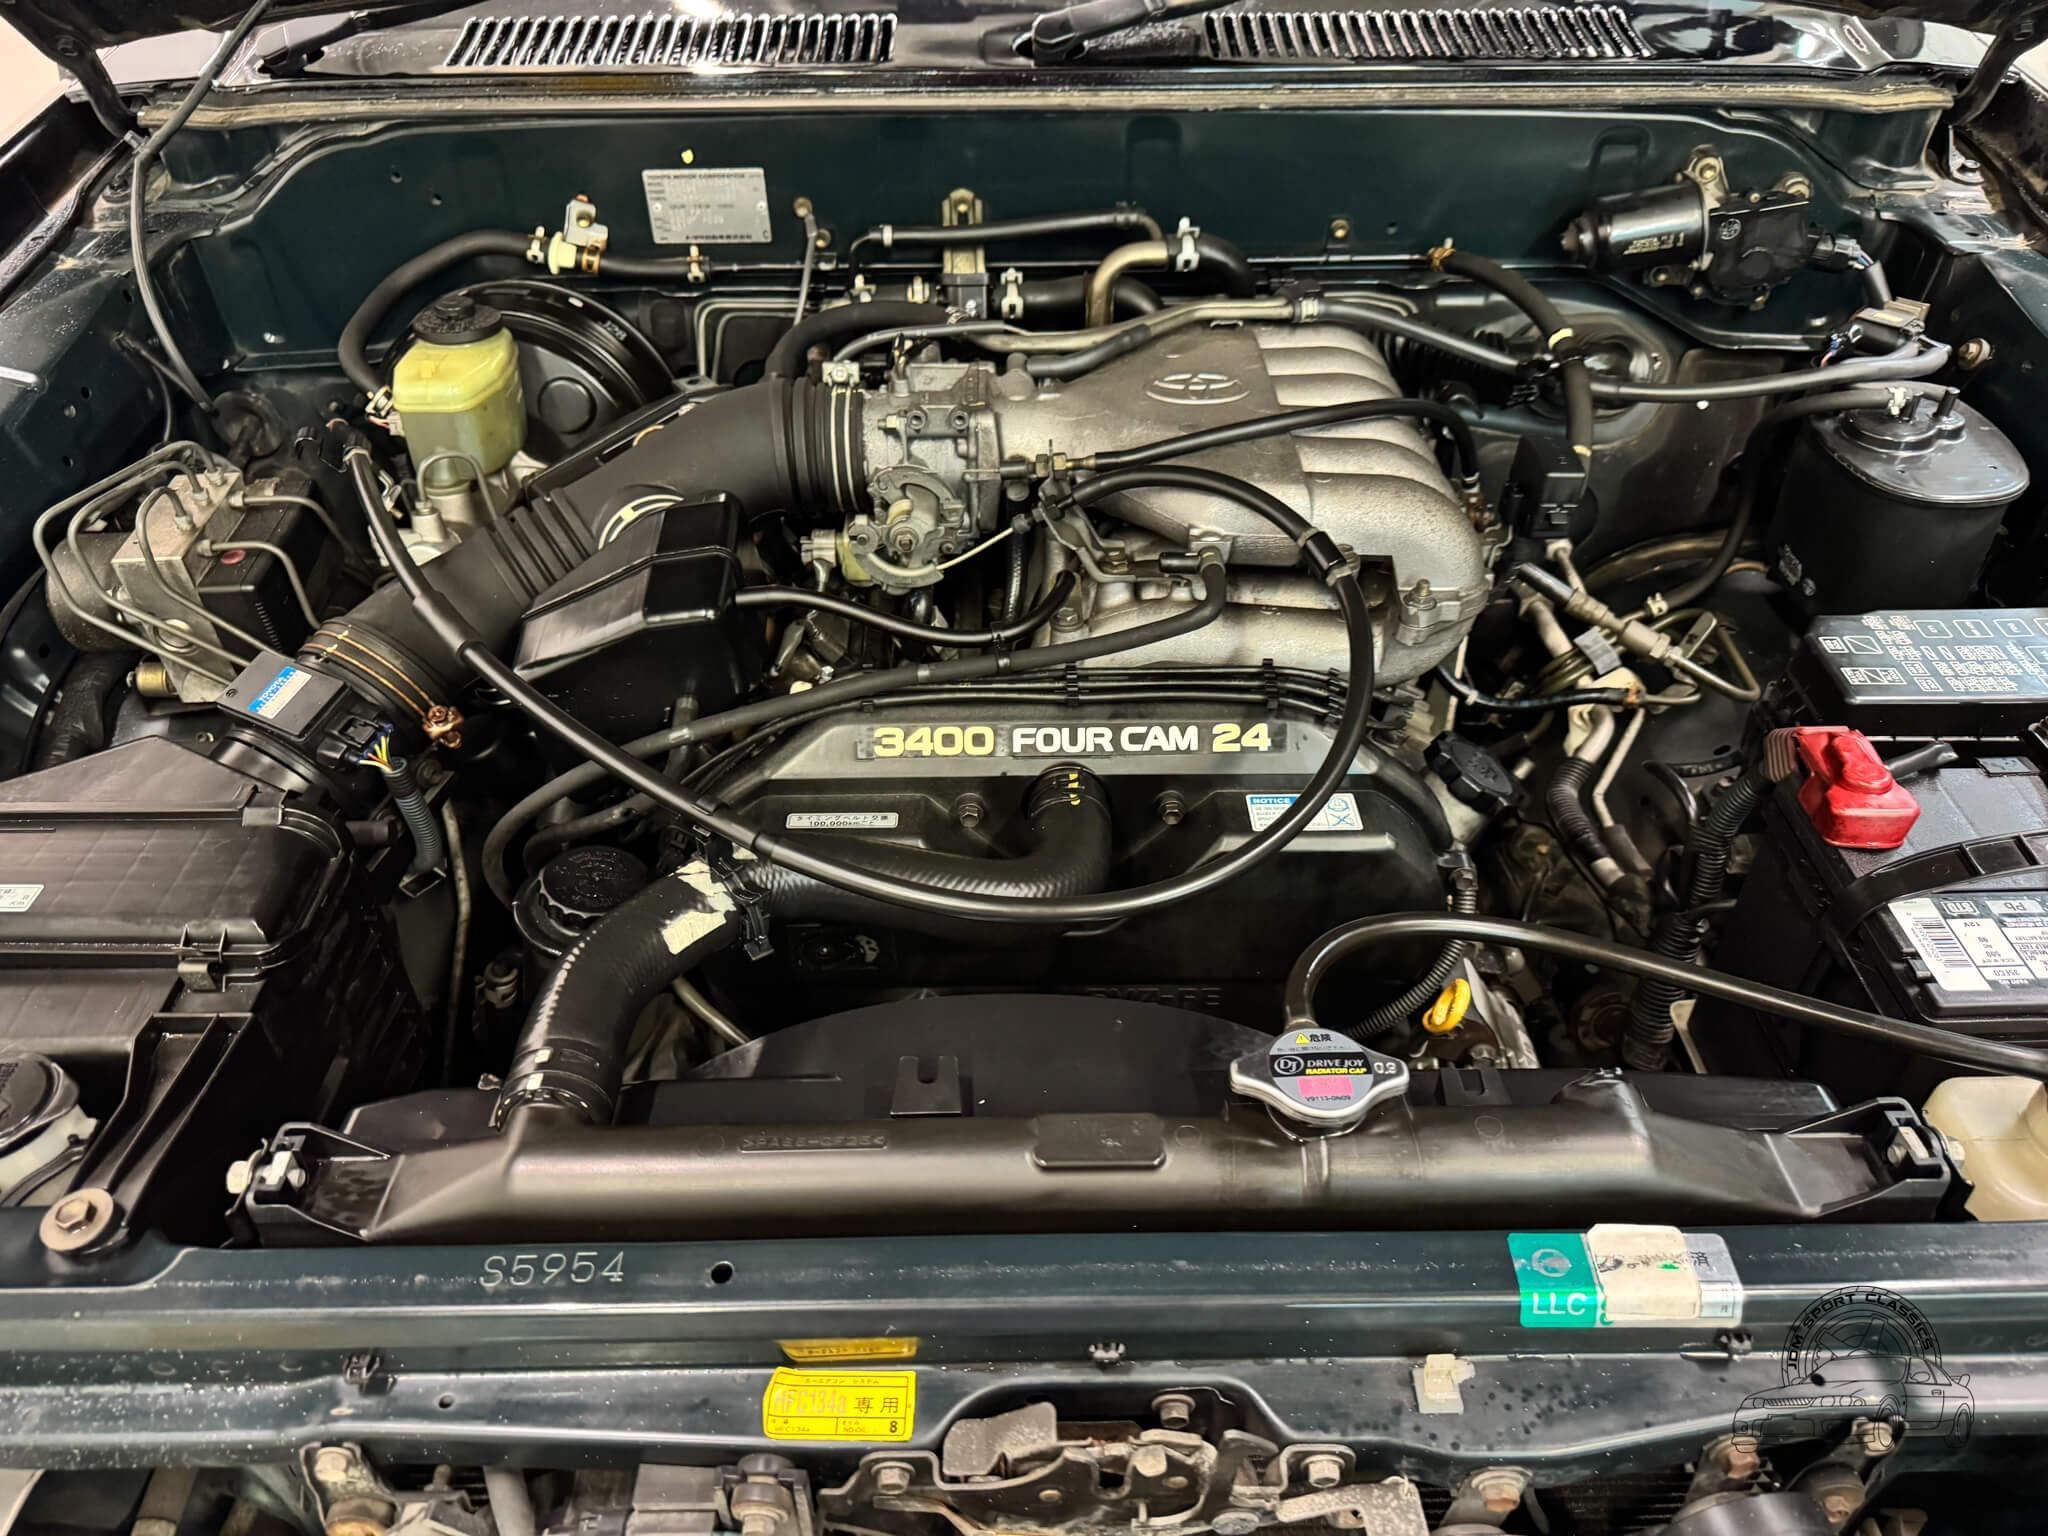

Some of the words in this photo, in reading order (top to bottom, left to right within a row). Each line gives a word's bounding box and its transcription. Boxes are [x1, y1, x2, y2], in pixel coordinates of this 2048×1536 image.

[874, 726, 994, 757] 3400
[1012, 727, 1113, 753] FOUR
[1120, 726, 1199, 752] CAM
[1211, 723, 1272, 753] 24
[1343, 1059, 1364, 1068] JOY
[479, 1250, 624, 1287] S5954
[1532, 1292, 1588, 1316] LLC
[889, 1420, 898, 1433] 8
